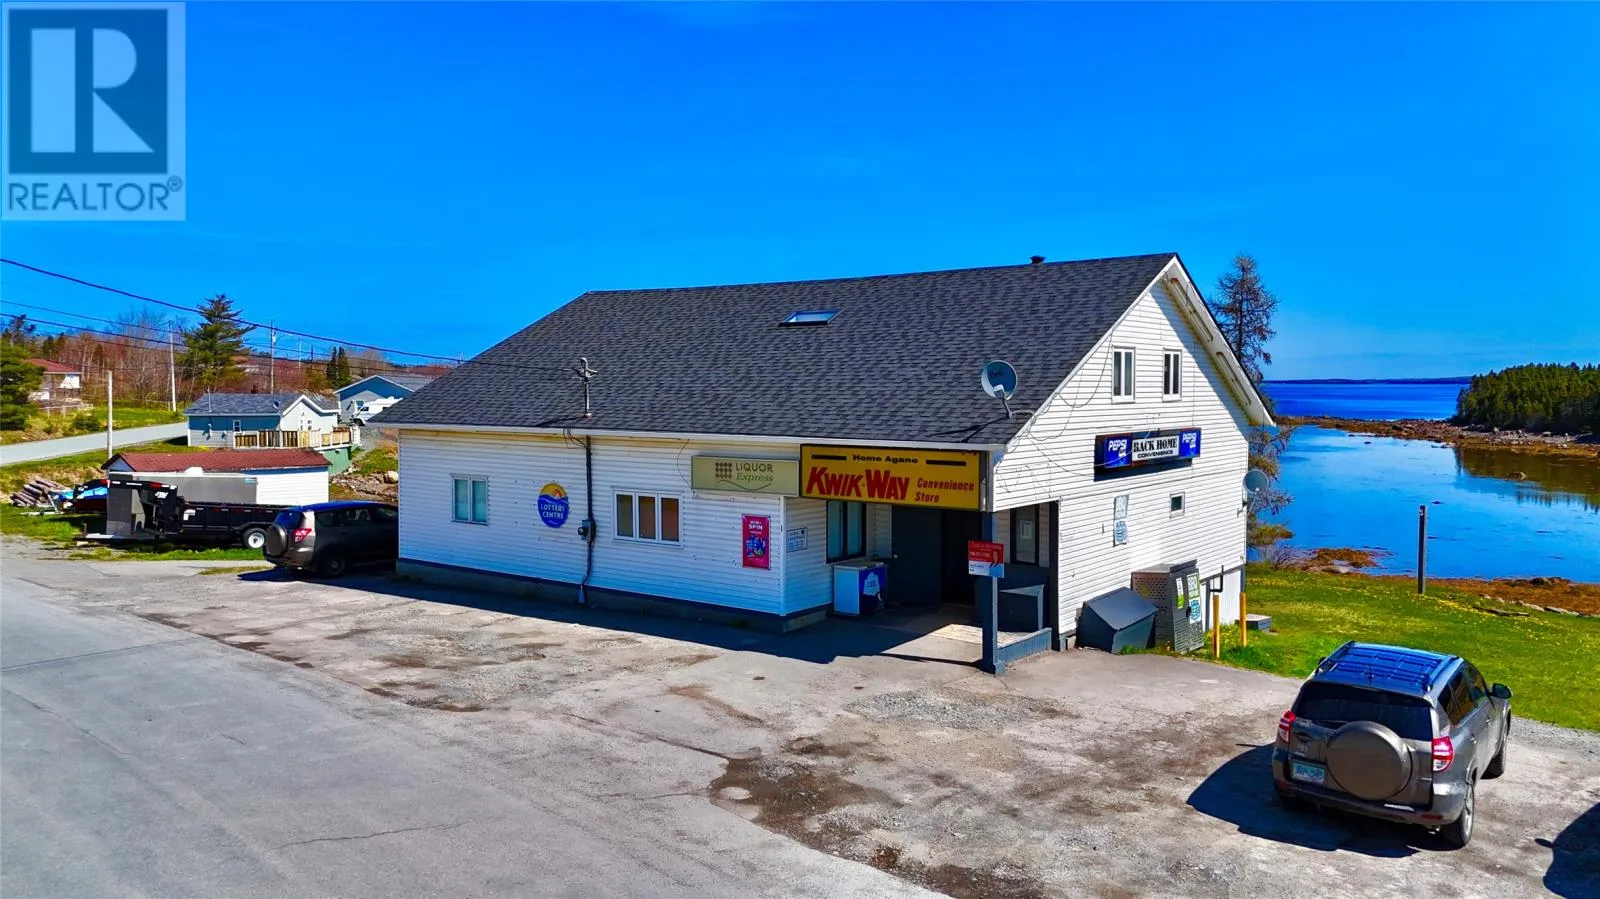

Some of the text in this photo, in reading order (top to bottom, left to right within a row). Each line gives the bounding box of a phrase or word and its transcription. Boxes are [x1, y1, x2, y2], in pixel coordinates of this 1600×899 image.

[1133, 438, 1178, 453] BACK HOME
[852, 454, 882, 462] Home
[1137, 449, 1174, 459] CONVENIENCE
[735, 462, 773, 472] LIQUOR
[736, 472, 774, 483] Express
[917, 477, 975, 492] Convenience
[915, 491, 940, 503] Store
[540, 503, 566, 512] LOTTERY
[542, 511, 564, 520] CENTRE
[748, 523, 763, 531] SPIN
